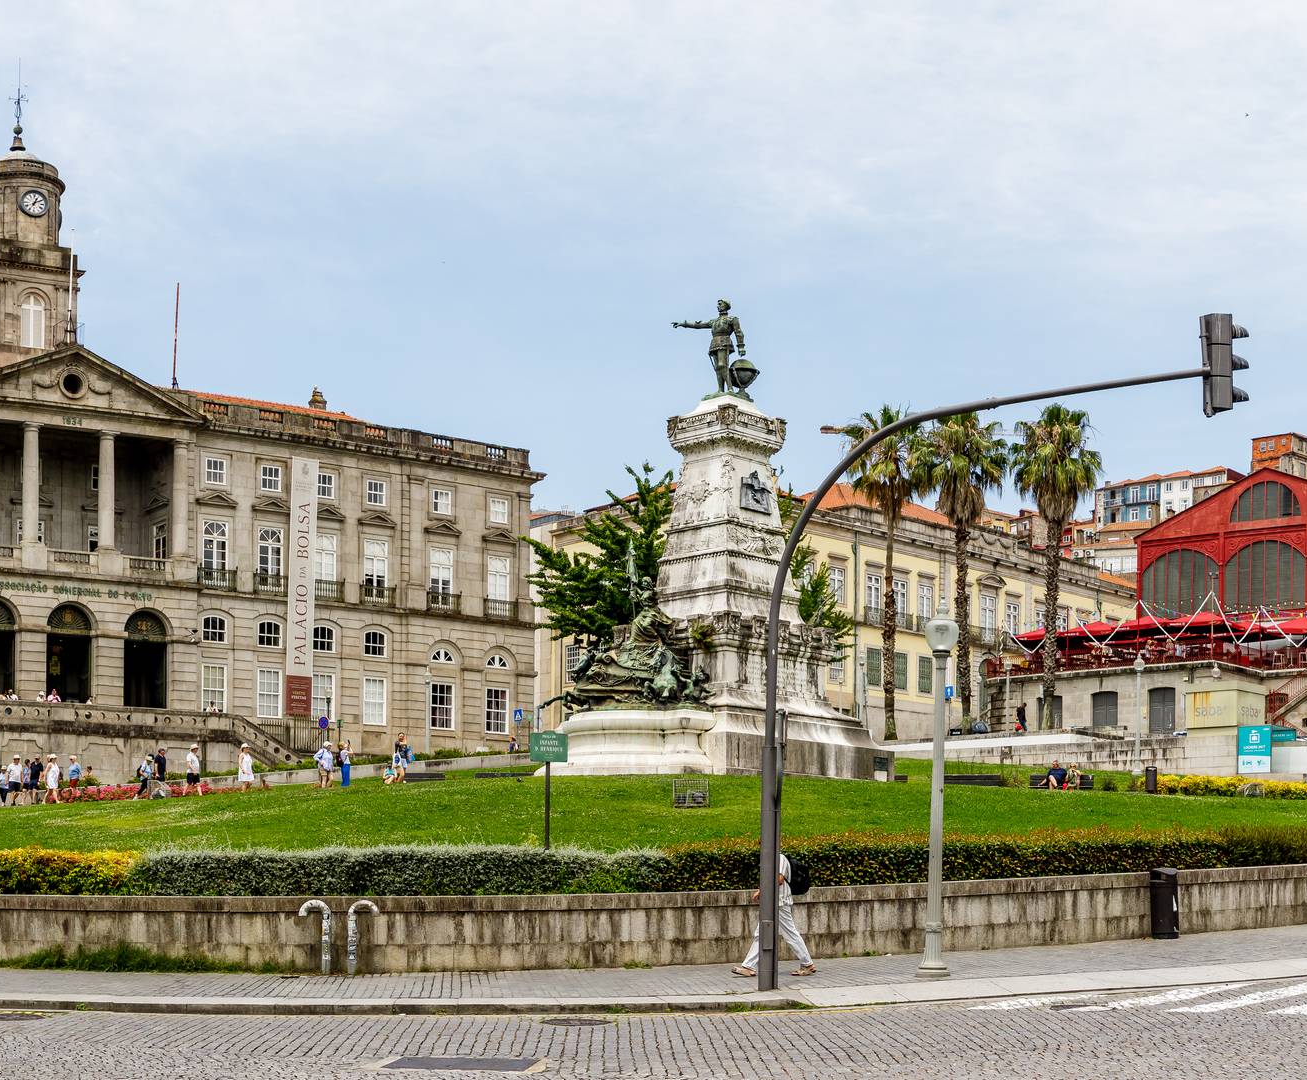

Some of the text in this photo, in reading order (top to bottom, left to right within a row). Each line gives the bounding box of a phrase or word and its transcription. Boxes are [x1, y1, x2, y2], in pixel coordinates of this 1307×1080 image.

[296, 502, 311, 560] BOLSA
[299, 566, 307, 579] DA
[53, 585, 102, 598] COMERCIAL
[107, 589, 119, 599] DO
[124, 591, 153, 601] PORTO
[292, 584, 309, 666] PALÁCIO
[1195, 705, 1222, 718] saba
[1240, 705, 1259, 718] saba
